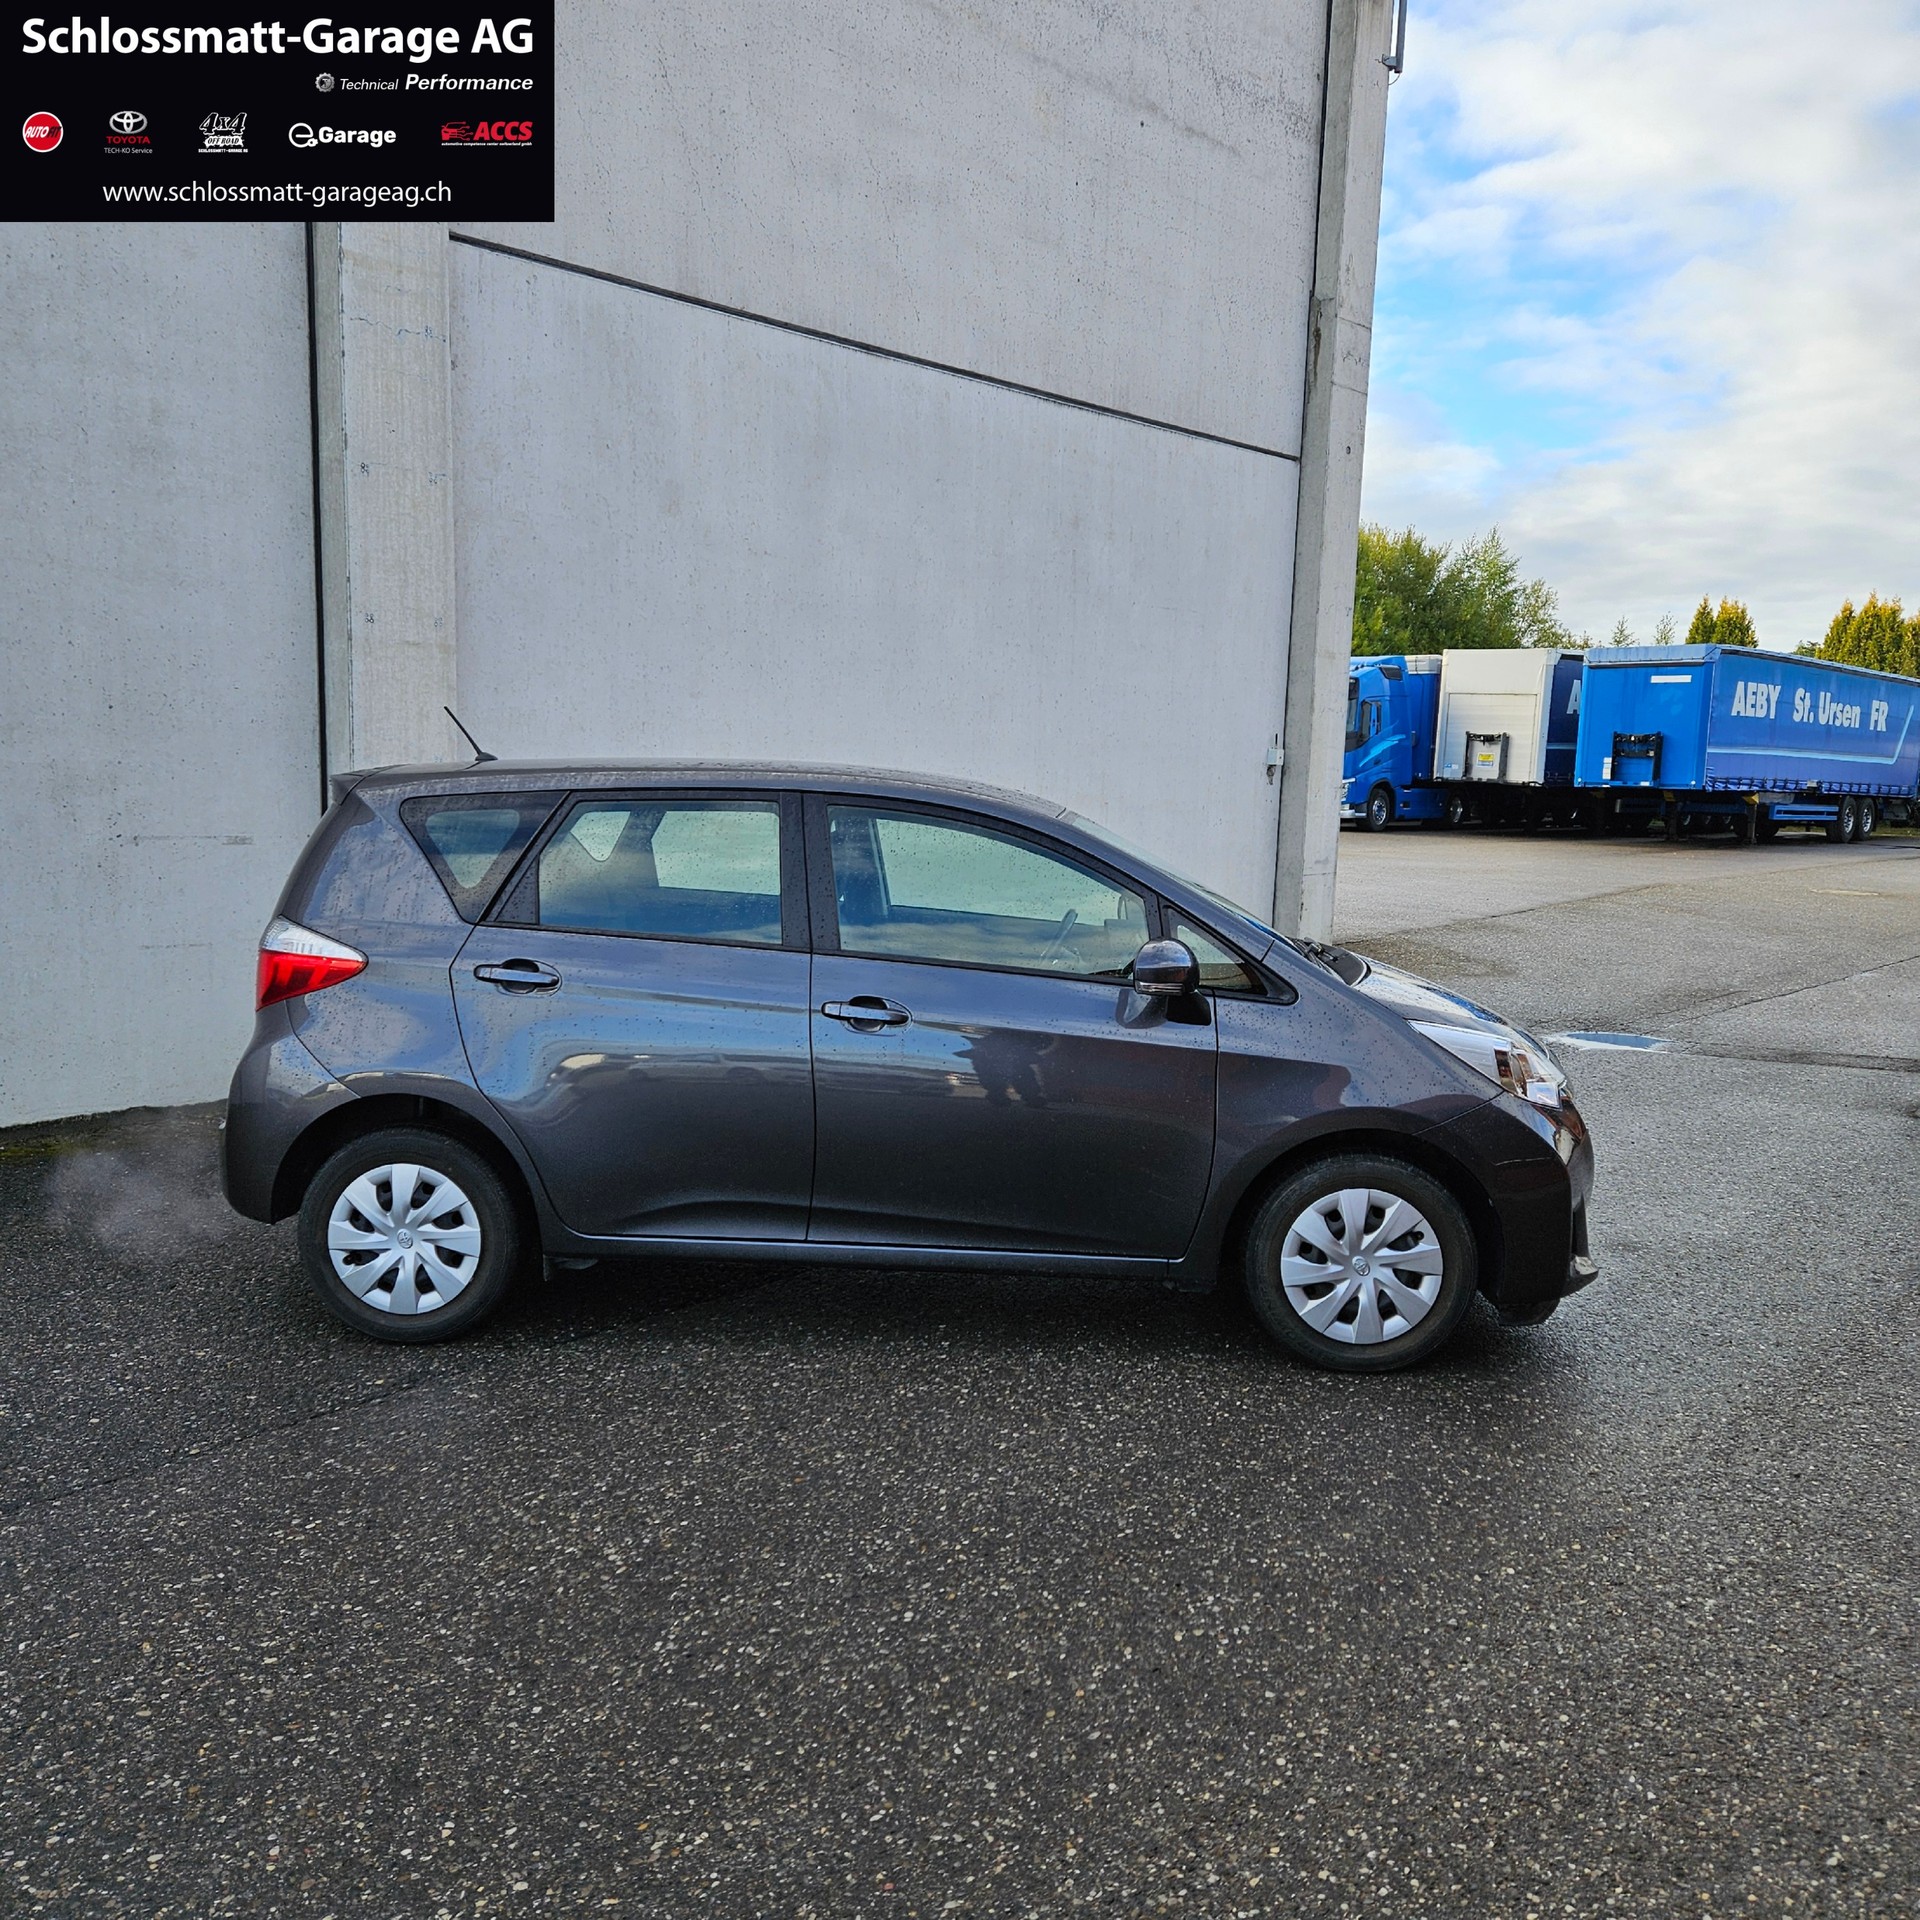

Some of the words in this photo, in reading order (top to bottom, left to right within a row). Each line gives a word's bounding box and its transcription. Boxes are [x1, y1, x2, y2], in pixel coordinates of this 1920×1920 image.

[1731, 681, 1781, 720] AEBY
[1793, 688, 1814, 724] St.
[1818, 691, 1861, 729] Ursen
[1869, 699, 1889, 732] FR
